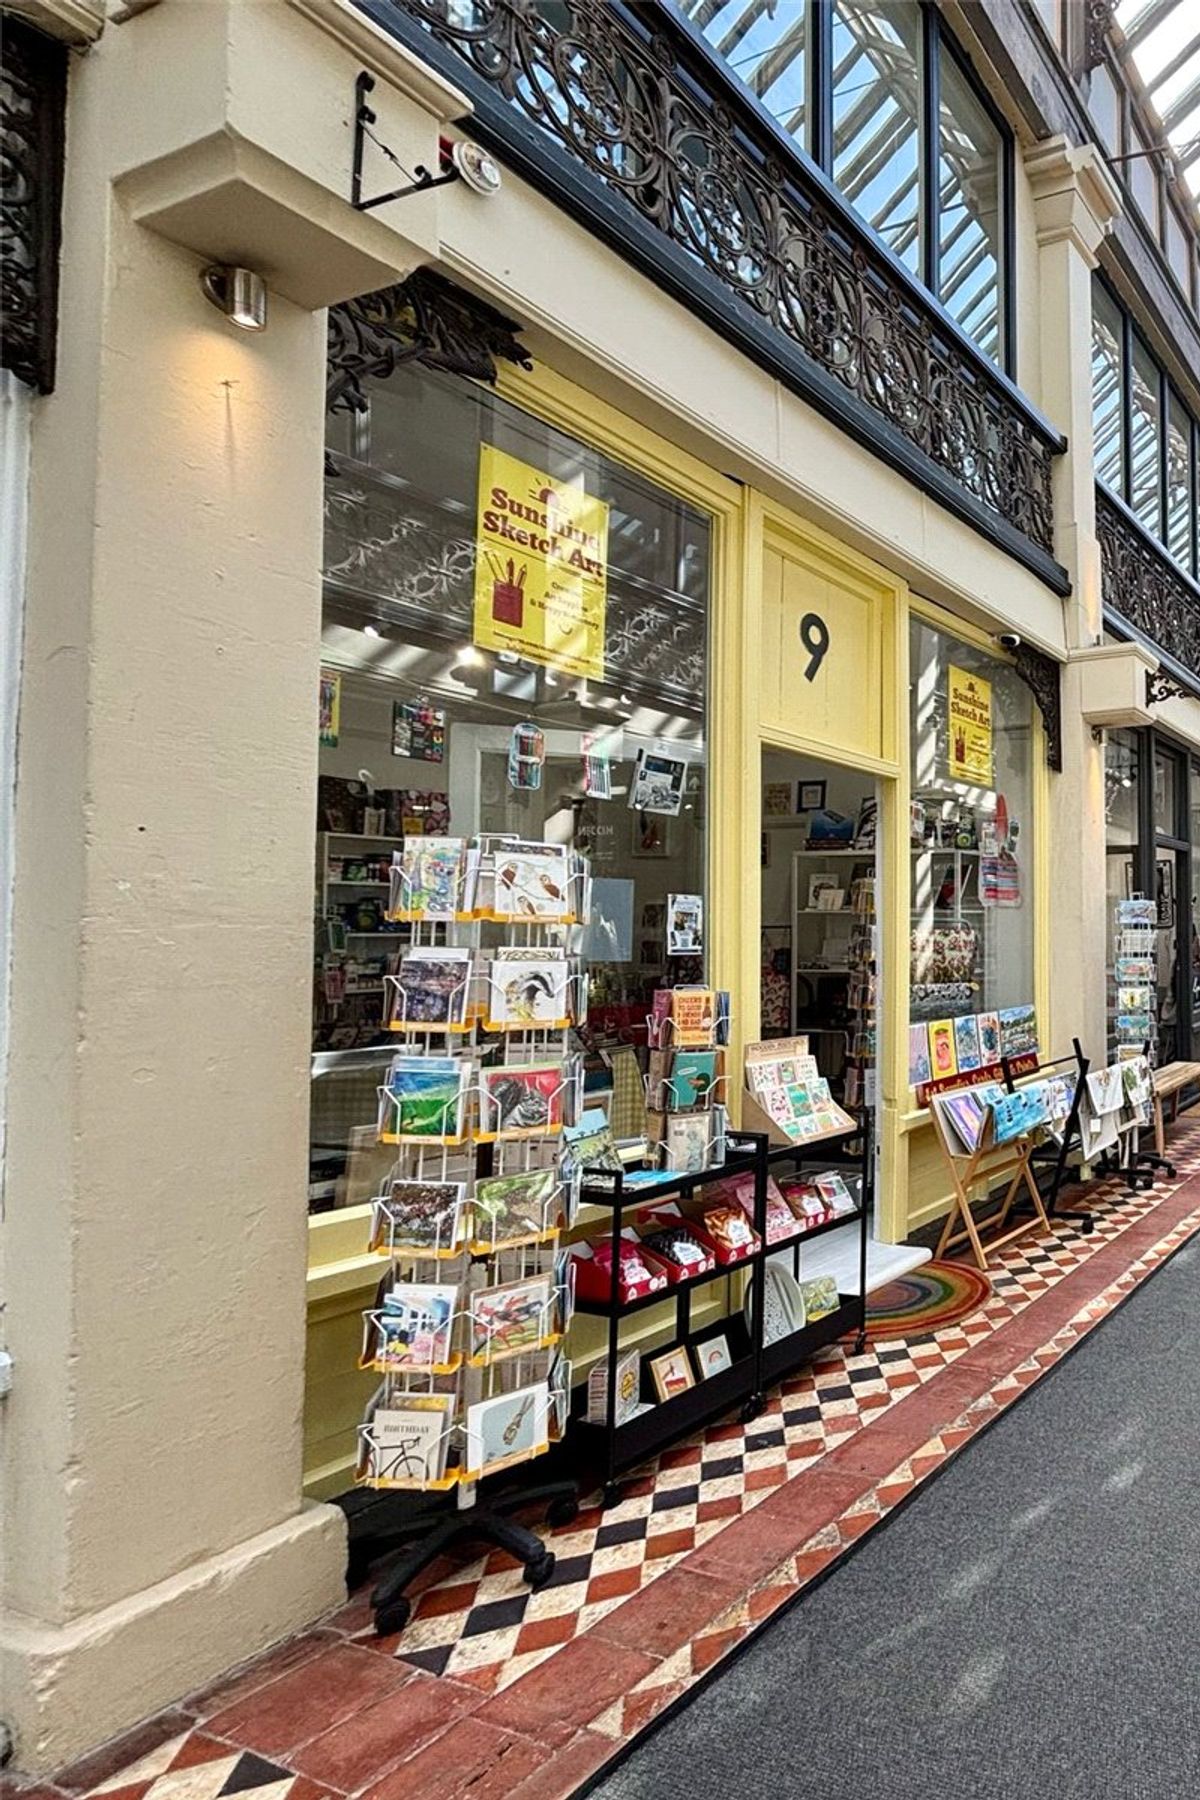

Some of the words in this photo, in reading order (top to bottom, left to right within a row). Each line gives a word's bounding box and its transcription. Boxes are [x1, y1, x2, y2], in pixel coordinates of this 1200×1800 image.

[482, 510, 564, 559] Sketch
[567, 548, 604, 577] Art
[490, 487, 600, 550] Sunshine
[800, 612, 829, 683] 9
[950, 701, 978, 722] Sketch
[952, 687, 989, 712] Sunshine
